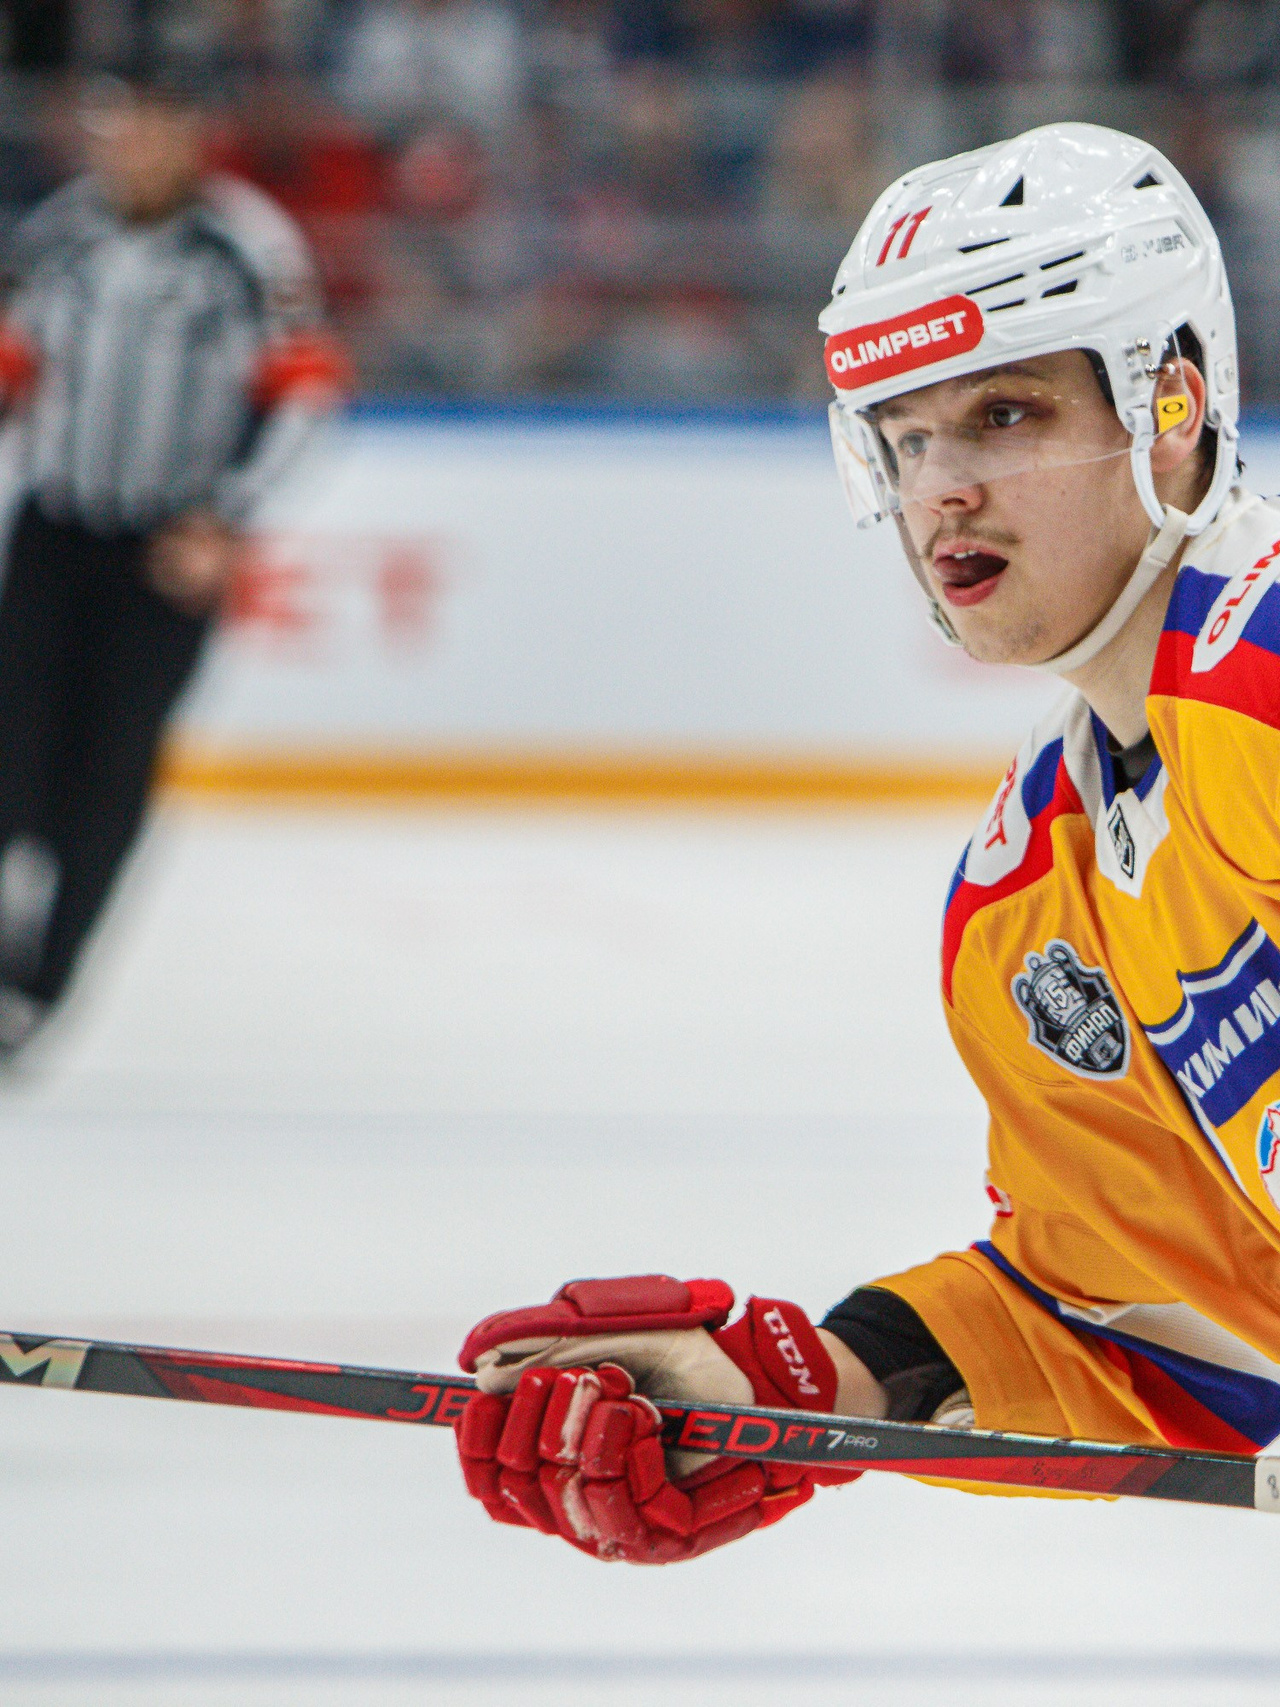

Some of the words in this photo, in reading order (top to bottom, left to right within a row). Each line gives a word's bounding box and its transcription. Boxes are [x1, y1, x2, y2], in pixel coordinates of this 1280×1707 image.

[875, 205, 934, 268] 11
[830, 310, 967, 374] OLIMPBET
[1065, 1003, 1120, 1061] ФИНАЛ
[763, 1306, 821, 1395] CCM
[843, 1434, 879, 1450] PRO
